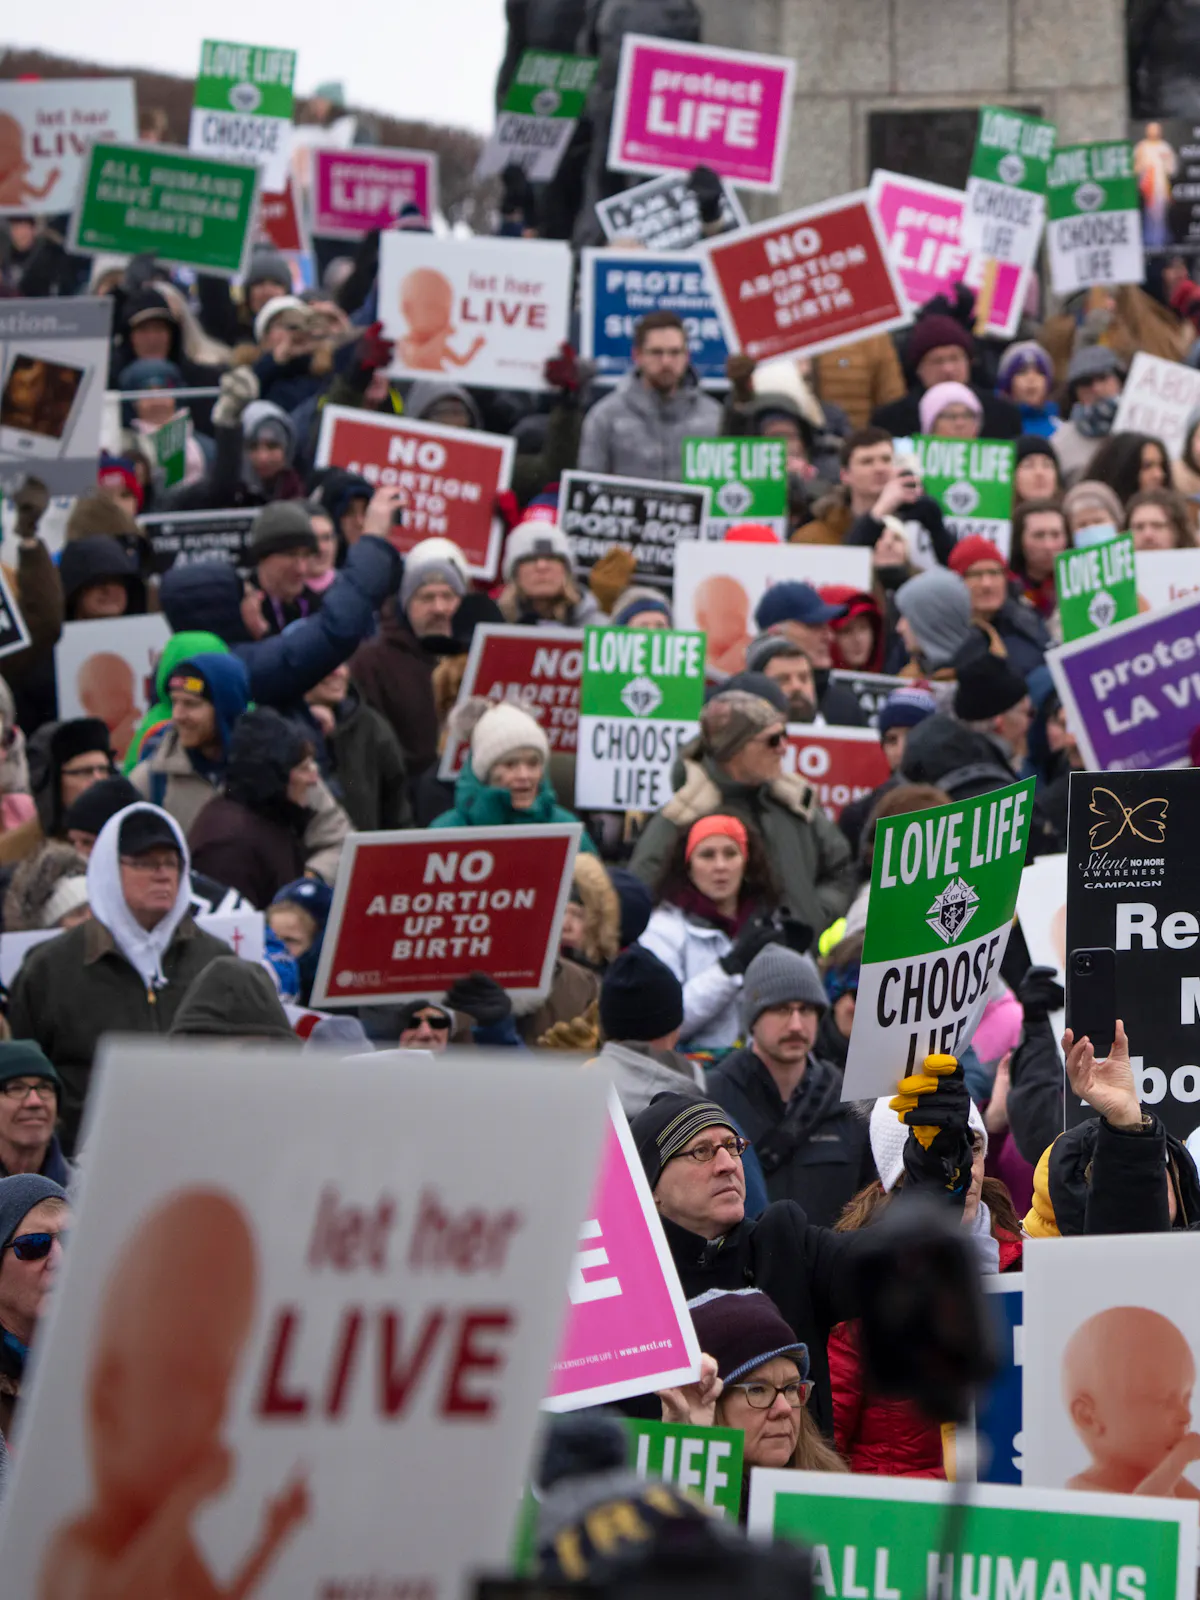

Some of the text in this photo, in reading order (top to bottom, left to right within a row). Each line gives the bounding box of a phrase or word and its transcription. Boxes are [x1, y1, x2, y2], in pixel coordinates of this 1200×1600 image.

[202, 41, 296, 85] LOVE LIFE
[651, 68, 765, 105] protect
[202, 116, 281, 154] CHOOSE
[645, 97, 760, 149] LIFE
[981, 111, 1058, 161] LOVE LIFE
[32, 130, 117, 158] LIV
[101, 158, 243, 200] ALL HUMANS
[1047, 144, 1132, 187] LOVE LIFE
[124, 206, 205, 239] RIGHTS
[159, 191, 240, 221] HUMAN
[896, 205, 963, 237] prot
[763, 228, 823, 265] NO
[1058, 213, 1131, 254] CHOOSE
[467, 272, 543, 297] let her
[737, 244, 868, 300] ABORTION
[773, 273, 845, 308] UP TO
[460, 297, 548, 330] LIVE
[774, 289, 856, 327] BIRTH
[389, 435, 447, 471] NO
[685, 441, 785, 481] LOVE LIFE
[917, 440, 1012, 483] LOVE LIFE
[592, 492, 636, 515] AM
[643, 498, 698, 522] THE
[1058, 538, 1135, 600] LOVE LIFE
[530, 647, 583, 680] NO
[587, 631, 701, 678] LOVE LIFE
[486, 680, 580, 705] ABORTI
[1103, 695, 1159, 736] LA
[612, 768, 661, 806] LIFE
[879, 789, 1029, 890] LOVE LIFE
[422, 850, 494, 885] NO
[1078, 851, 1165, 871] Silent NO MORE
[1083, 868, 1165, 877] AWARENESS
[365, 888, 537, 917] ABORTION
[1083, 880, 1162, 890] CAMPAIGN
[403, 912, 491, 936] UP TO
[391, 935, 493, 961] BIRTH
[876, 934, 1001, 1029] CHOOSE
[306, 1182, 398, 1274] let
[406, 1181, 524, 1275] her
[254, 1303, 516, 1424] LIVE
[619, 1338, 673, 1358] www.mccl.org
[812, 1544, 1148, 1600] ALL HUMANS
